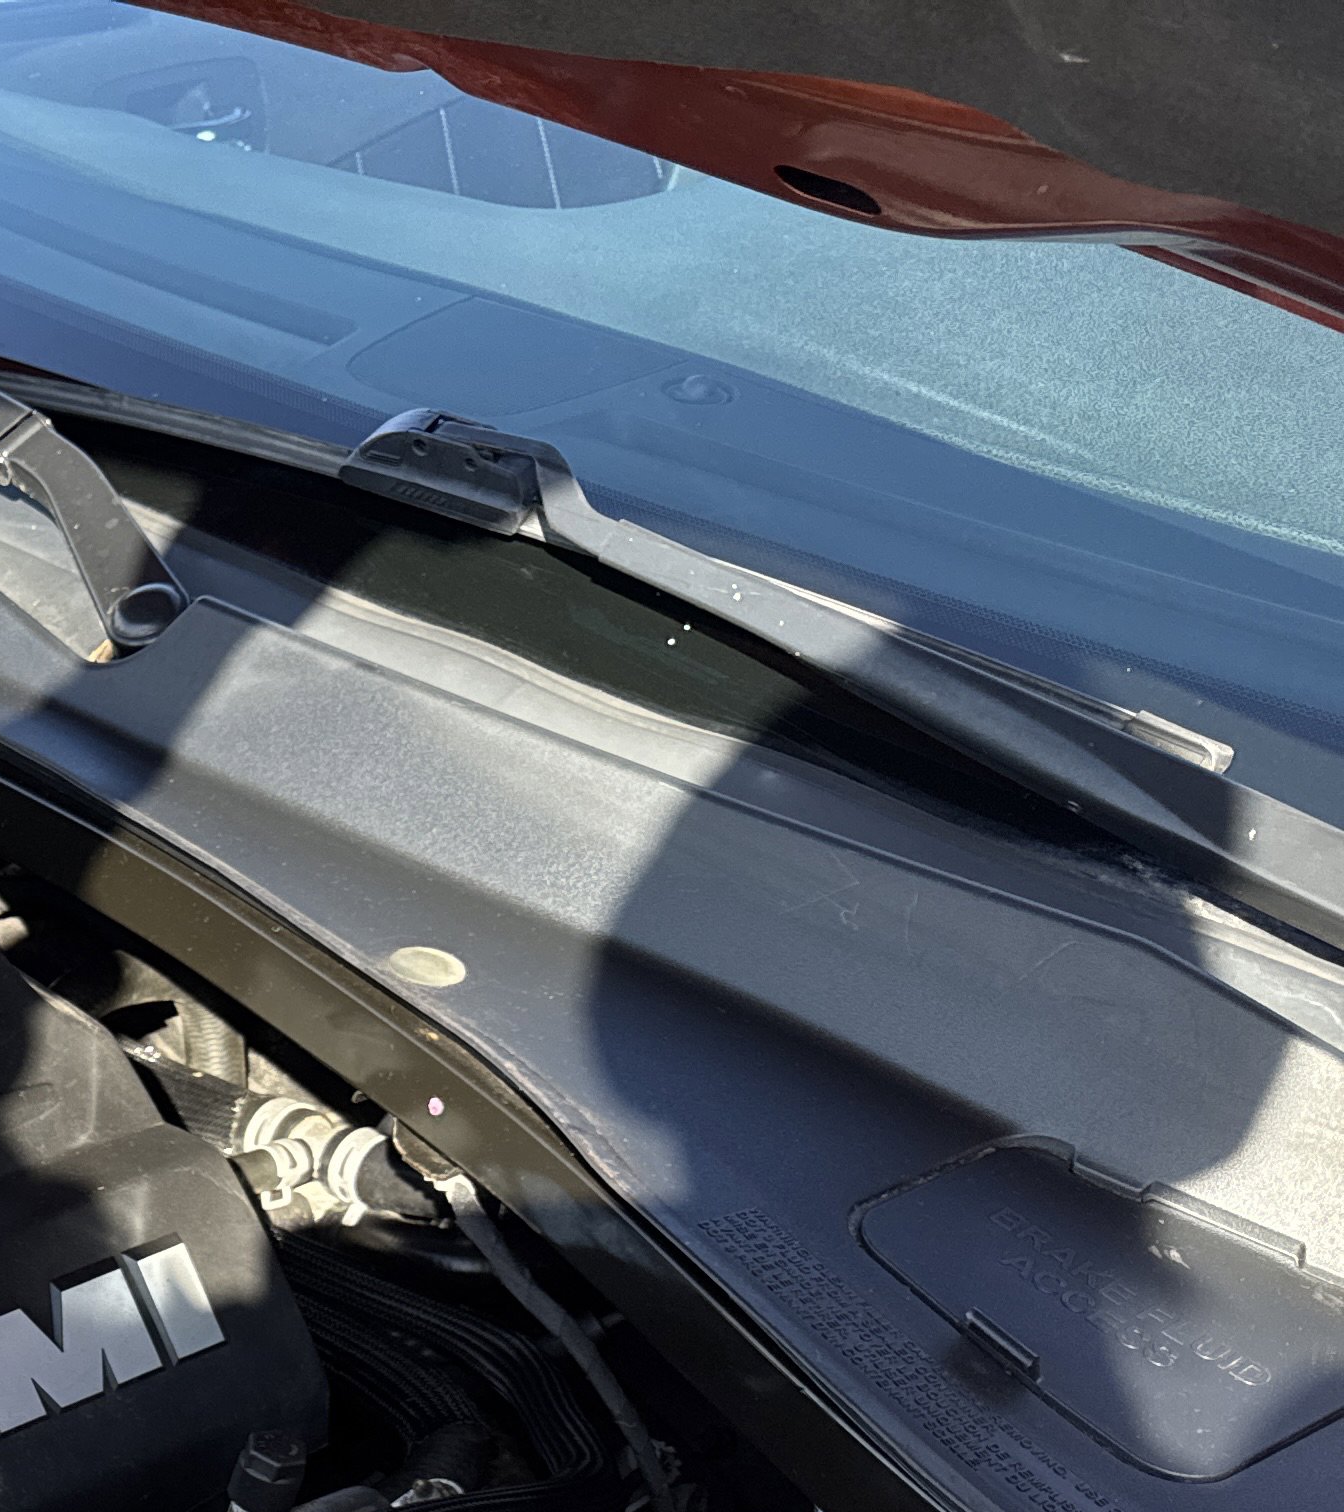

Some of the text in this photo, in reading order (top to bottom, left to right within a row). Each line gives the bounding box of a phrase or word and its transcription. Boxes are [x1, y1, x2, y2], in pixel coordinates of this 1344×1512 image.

[984, 1206, 1272, 1387] BRAKE FLUID
[998, 1255, 1178, 1368] ACCESS
[1005, 1475, 1031, 1493] DU
[1075, 1482, 1108, 1507] USE
